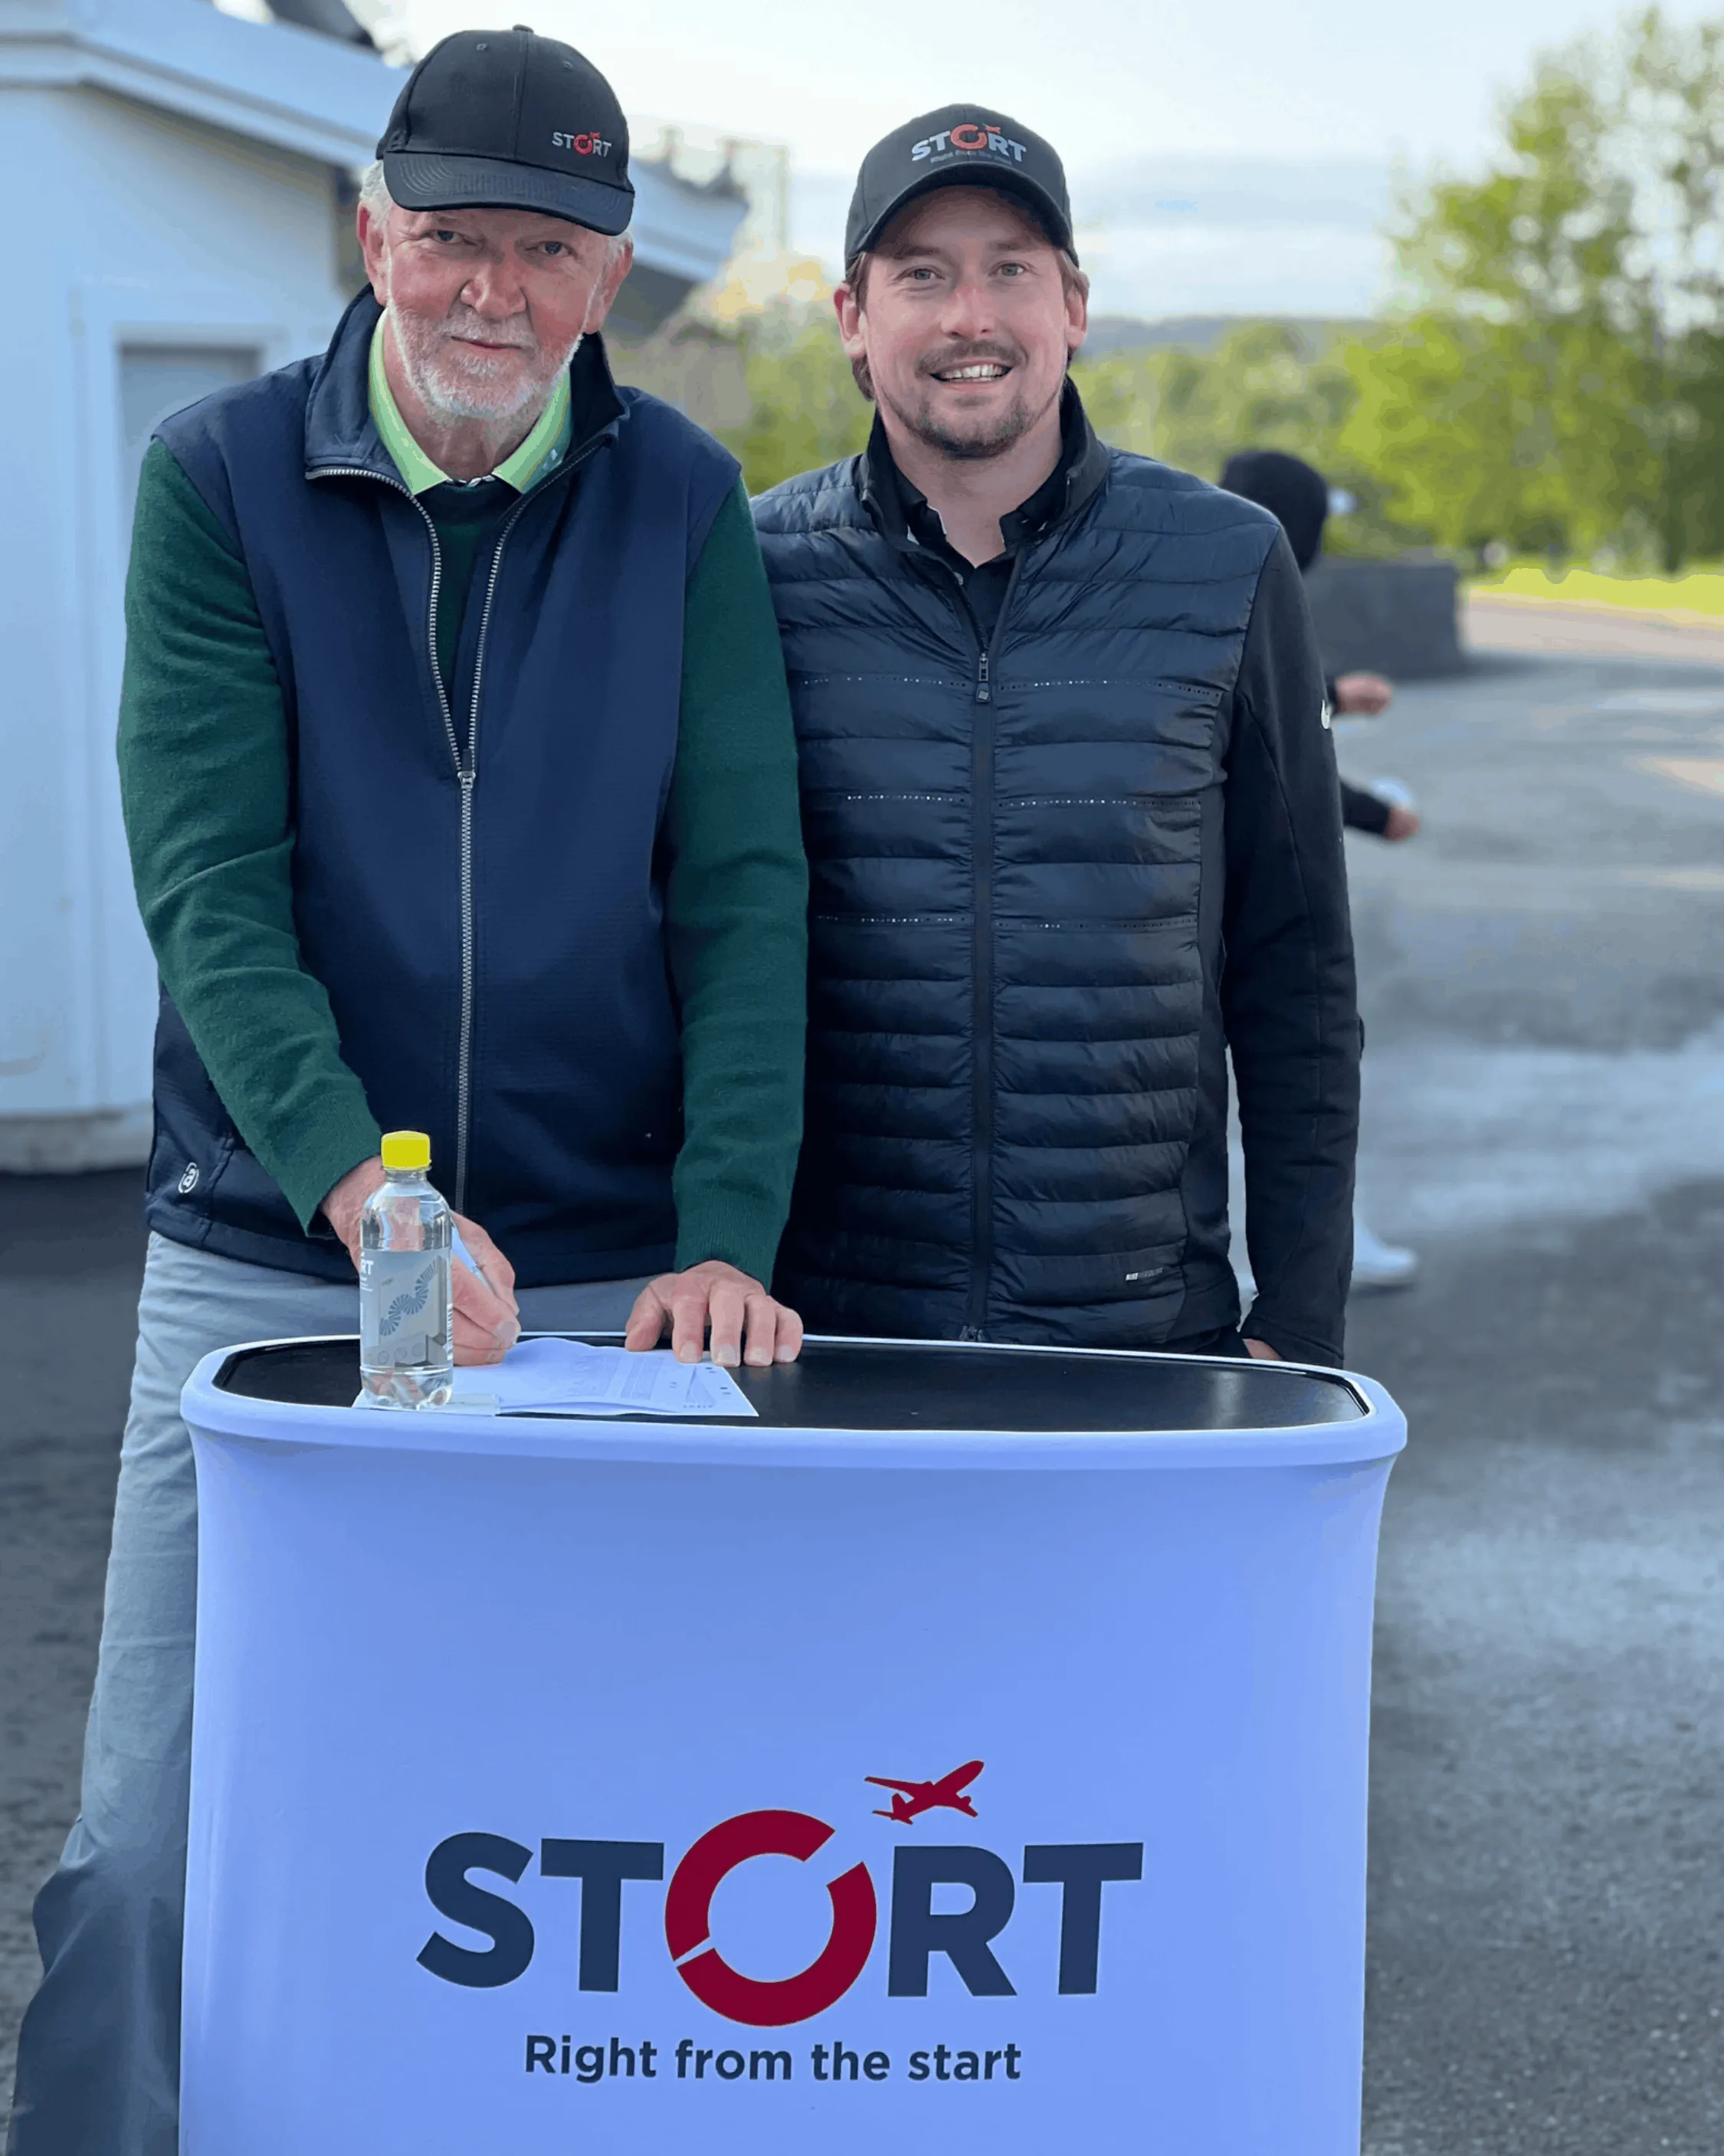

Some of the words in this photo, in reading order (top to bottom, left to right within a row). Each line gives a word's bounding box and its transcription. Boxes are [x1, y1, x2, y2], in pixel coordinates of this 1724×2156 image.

[526, 2035, 657, 2083] Right
[675, 2039, 792, 2080] from
[811, 2041, 890, 2081] the
[908, 2043, 1021, 2081] start
